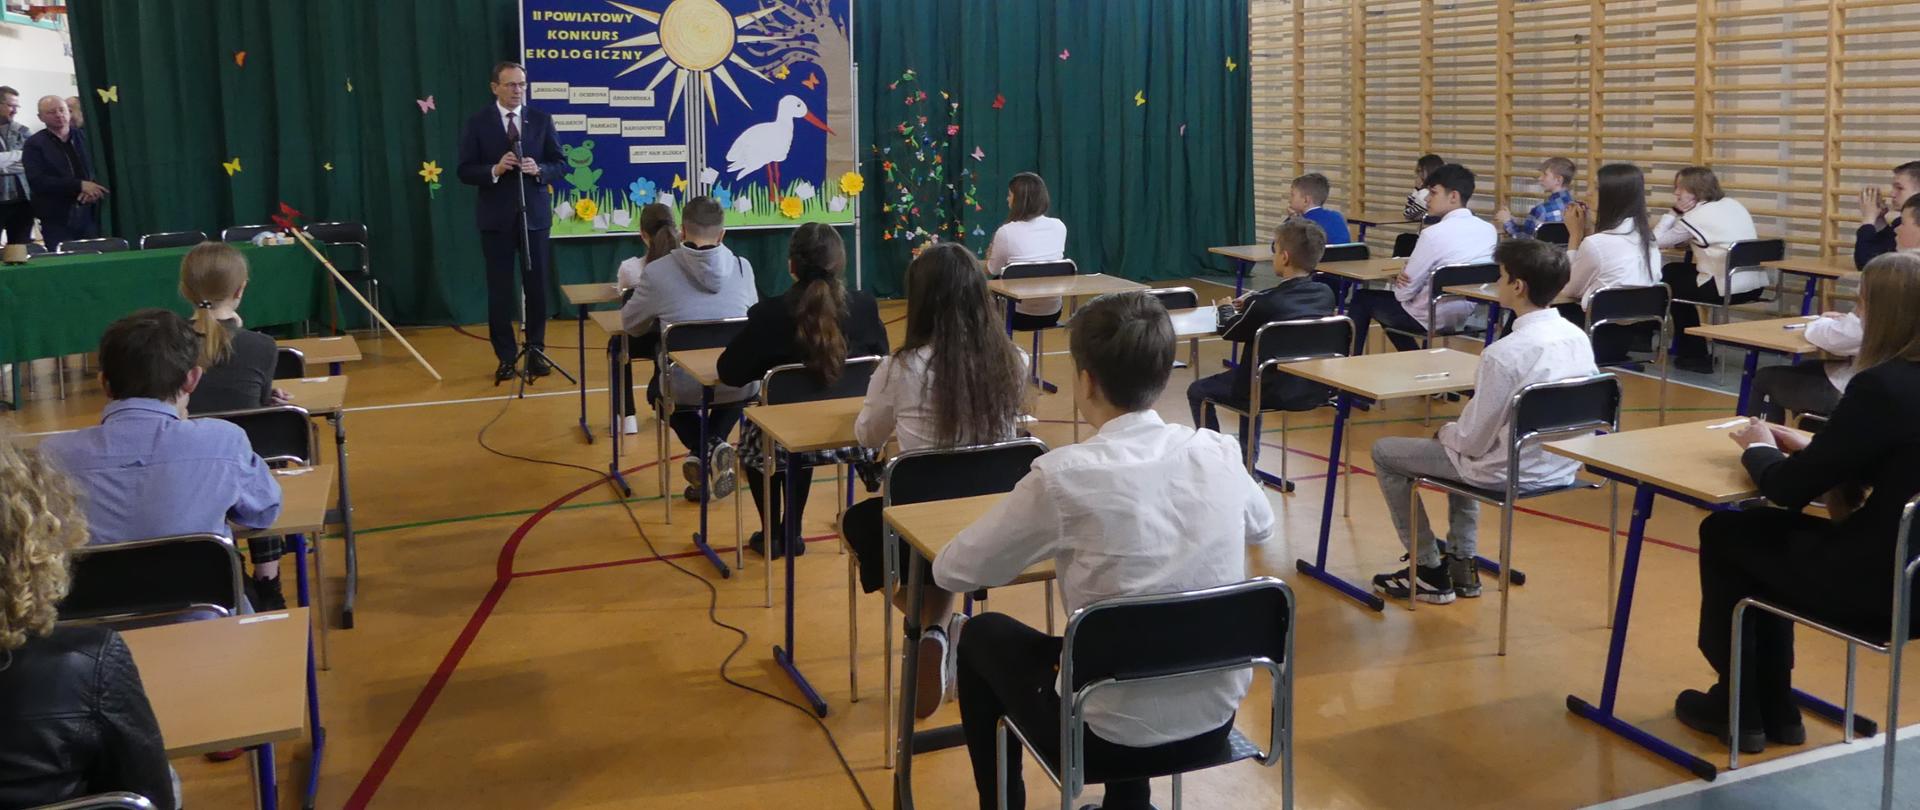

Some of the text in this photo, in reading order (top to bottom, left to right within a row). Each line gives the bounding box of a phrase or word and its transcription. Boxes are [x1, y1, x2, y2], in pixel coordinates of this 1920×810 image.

[532, 10, 634, 23] II POWIATOWY
[547, 30, 619, 41] KONKURS
[526, 48, 643, 60] EKOLOGICZNY
